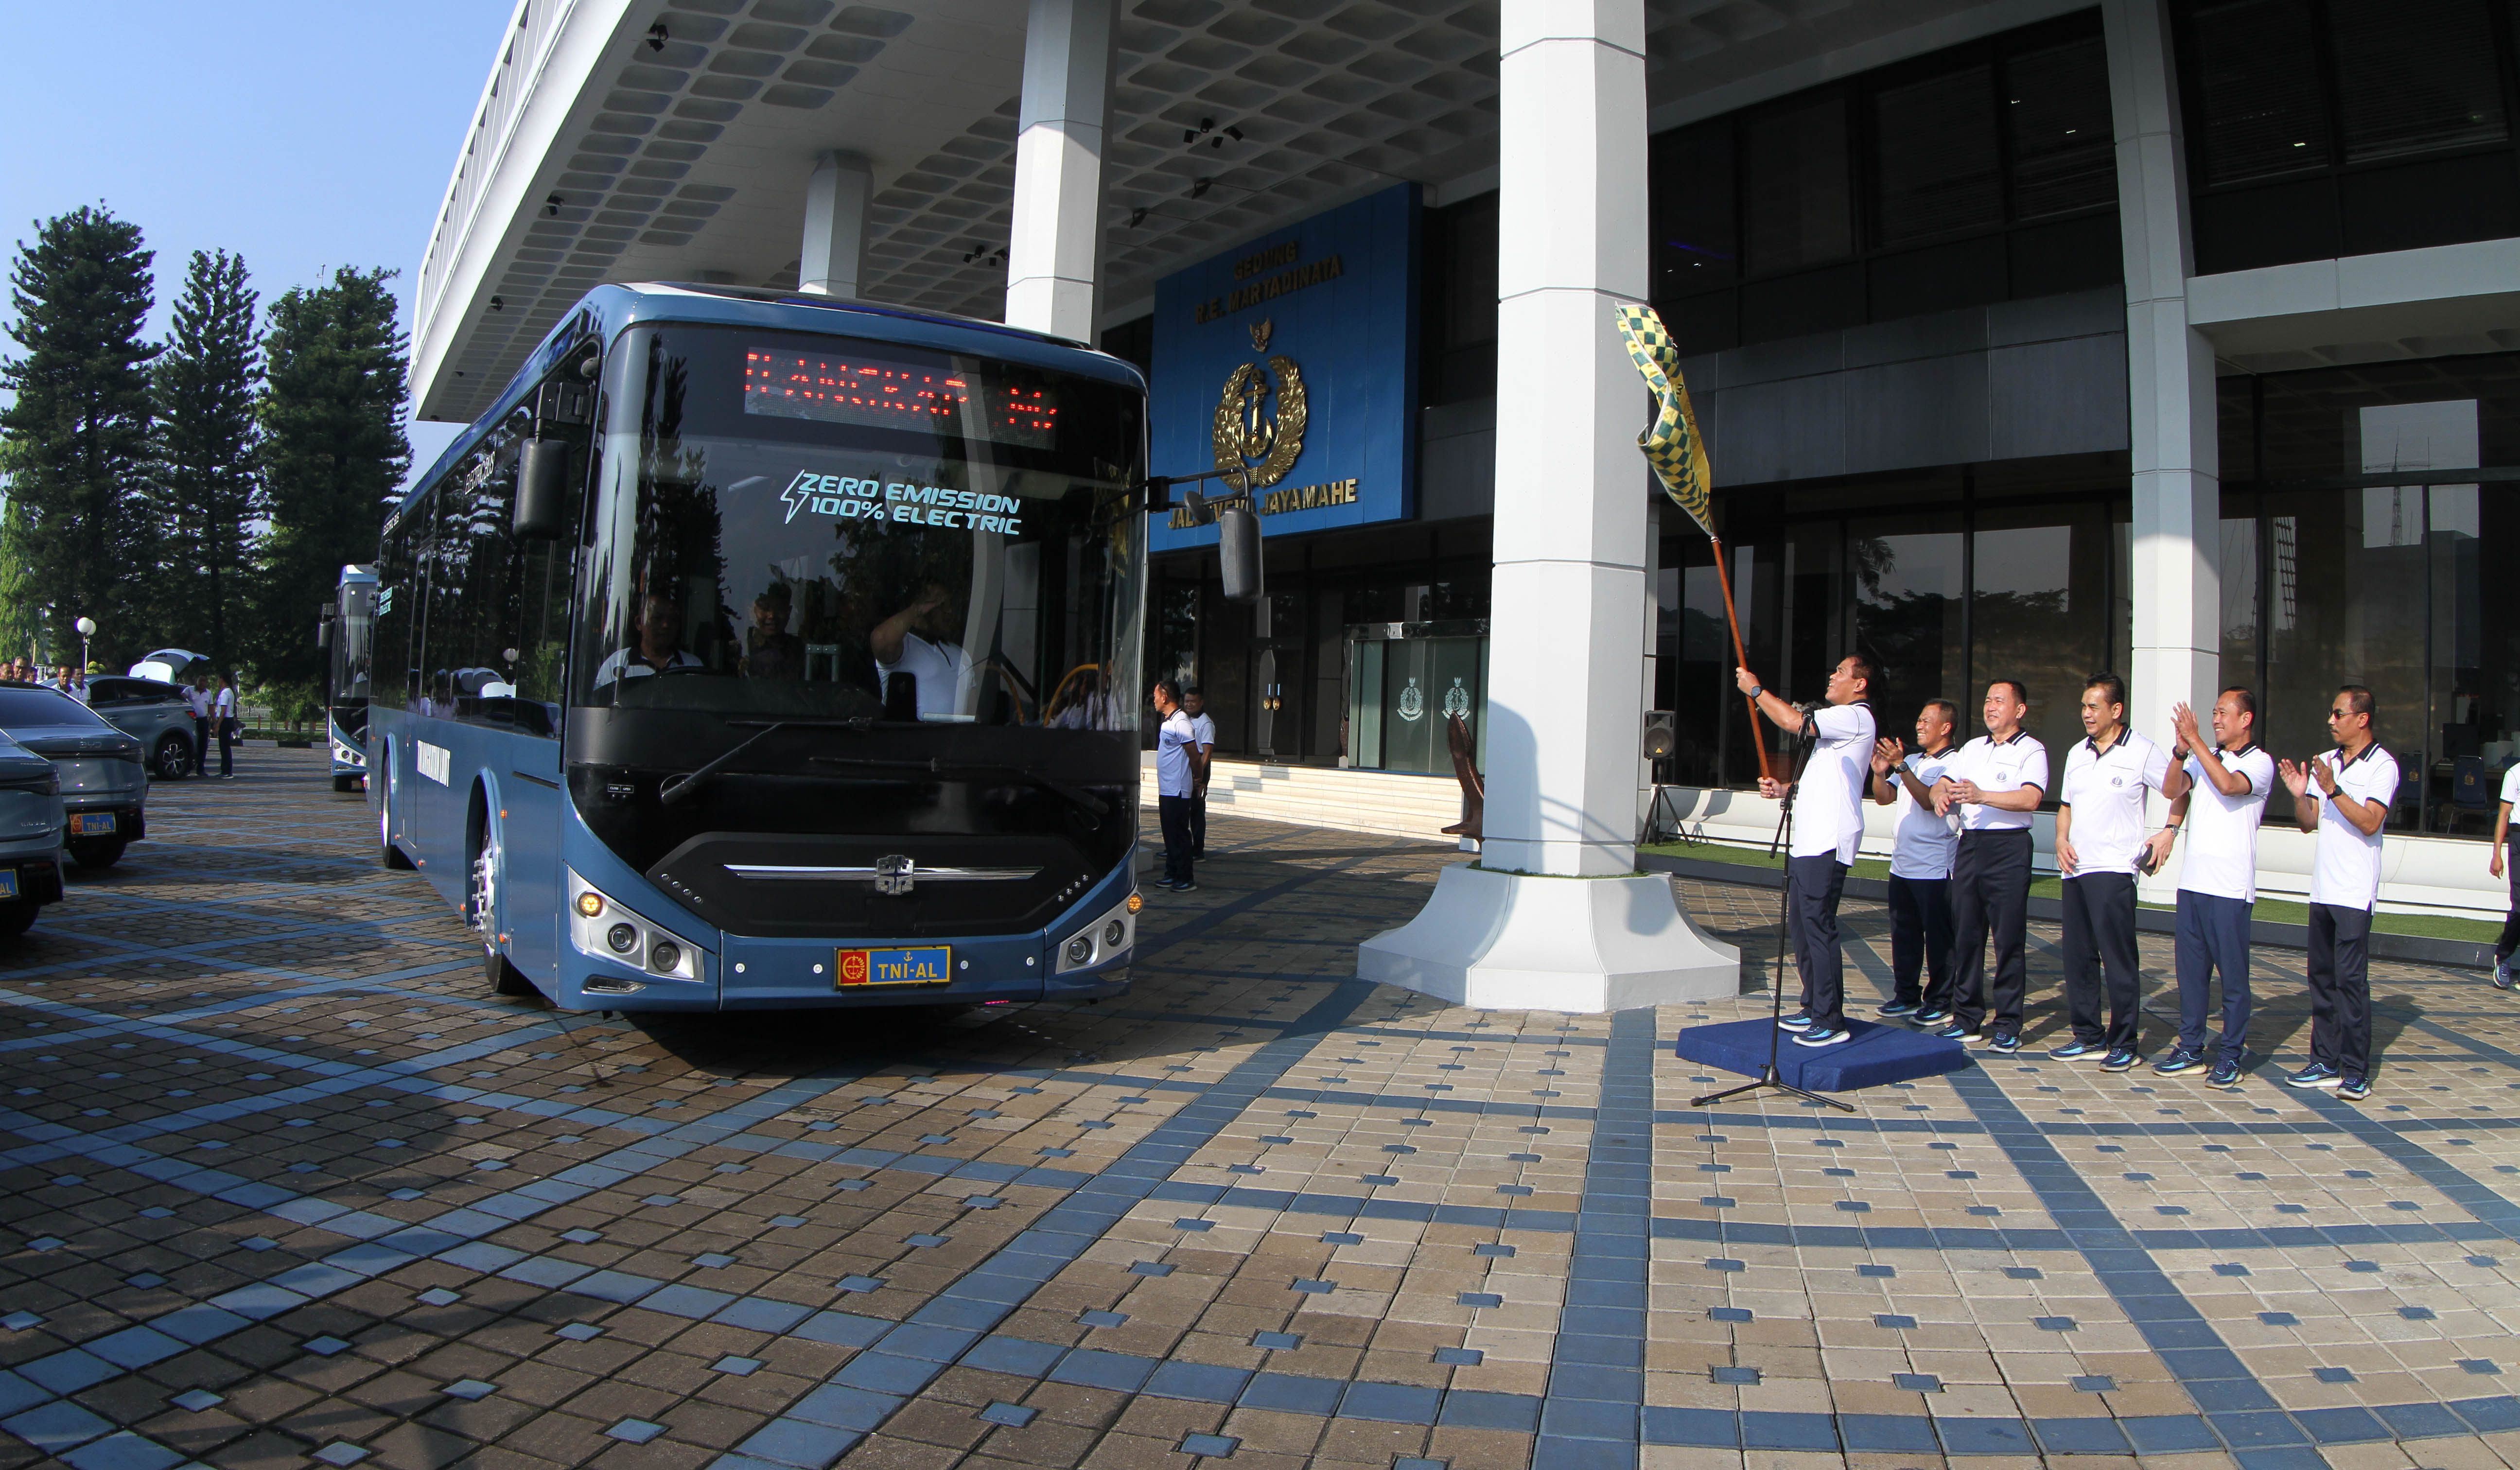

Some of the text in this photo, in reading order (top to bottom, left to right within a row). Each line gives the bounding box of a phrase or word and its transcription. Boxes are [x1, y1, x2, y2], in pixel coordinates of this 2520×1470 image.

[1234, 241, 1298, 280] GEDUNG
[1195, 255, 1343, 324] R.E. MARTADINATA
[798, 472, 1020, 514] ZERO EMISSION
[1260, 478, 1358, 517] JAYAMAHE
[810, 496, 1022, 535] 100% ELECTRIC
[86, 822, 111, 831] TNI-AL
[877, 962, 938, 980] TNI-AL
